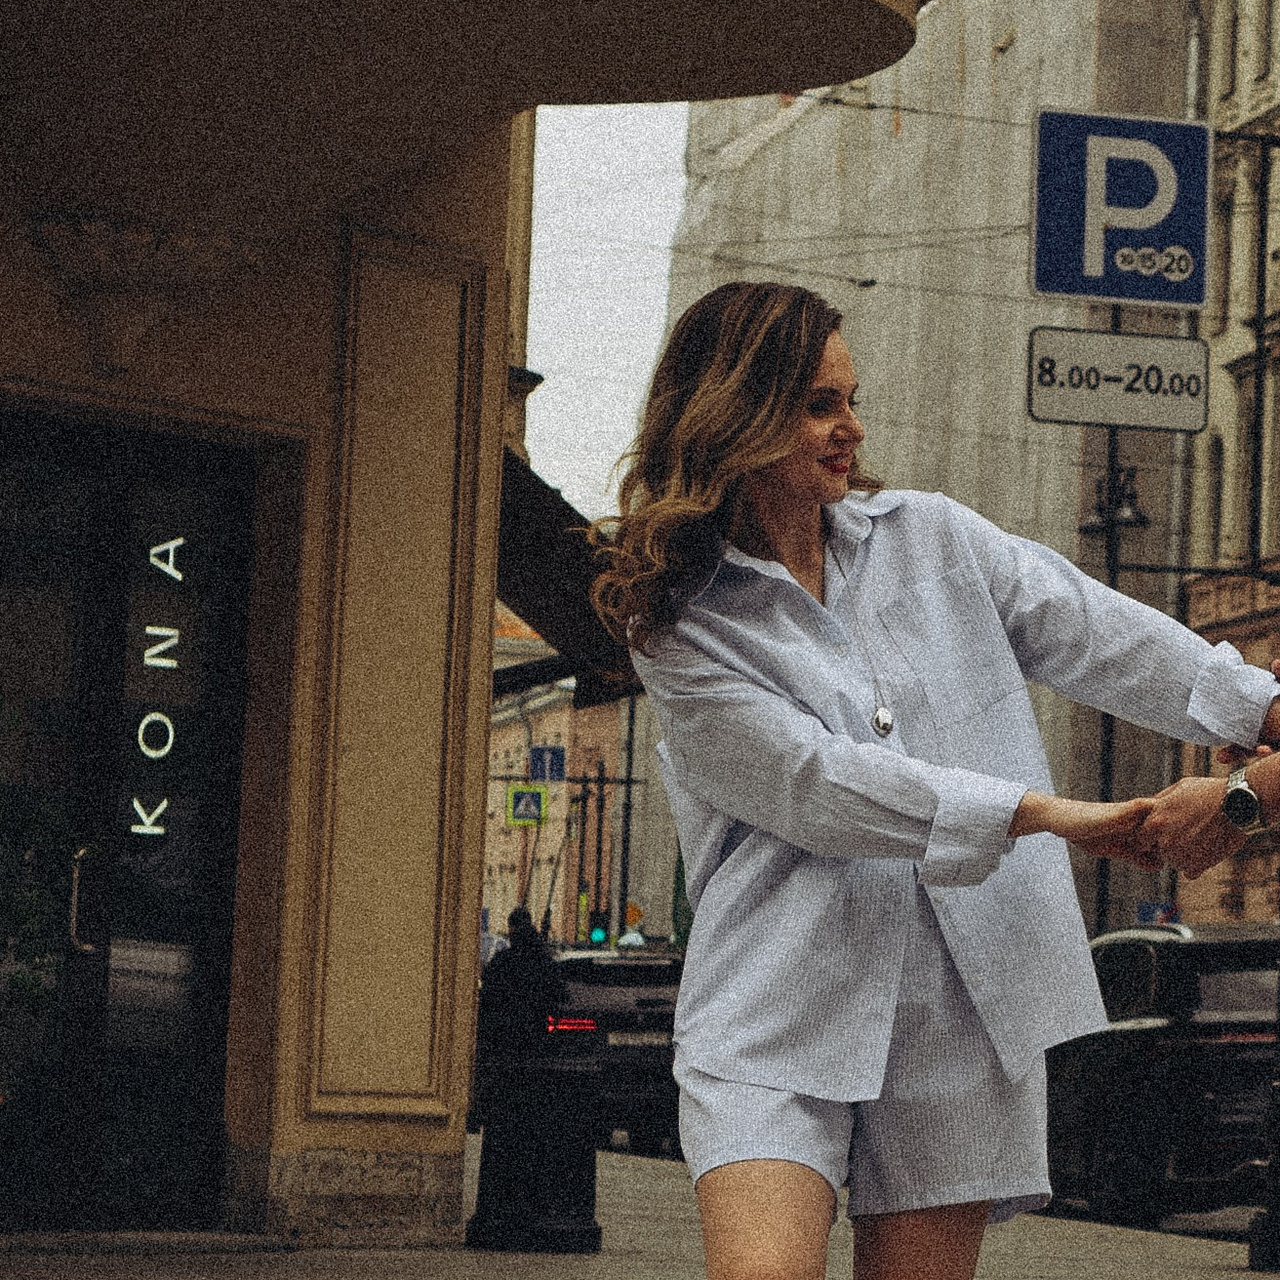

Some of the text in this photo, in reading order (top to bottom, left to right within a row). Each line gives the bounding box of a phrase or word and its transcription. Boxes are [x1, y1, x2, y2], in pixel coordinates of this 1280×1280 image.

[1084, 135, 1178, 277] P
[1163, 251, 1191, 275] 20
[130, 536, 187, 837] KONA
